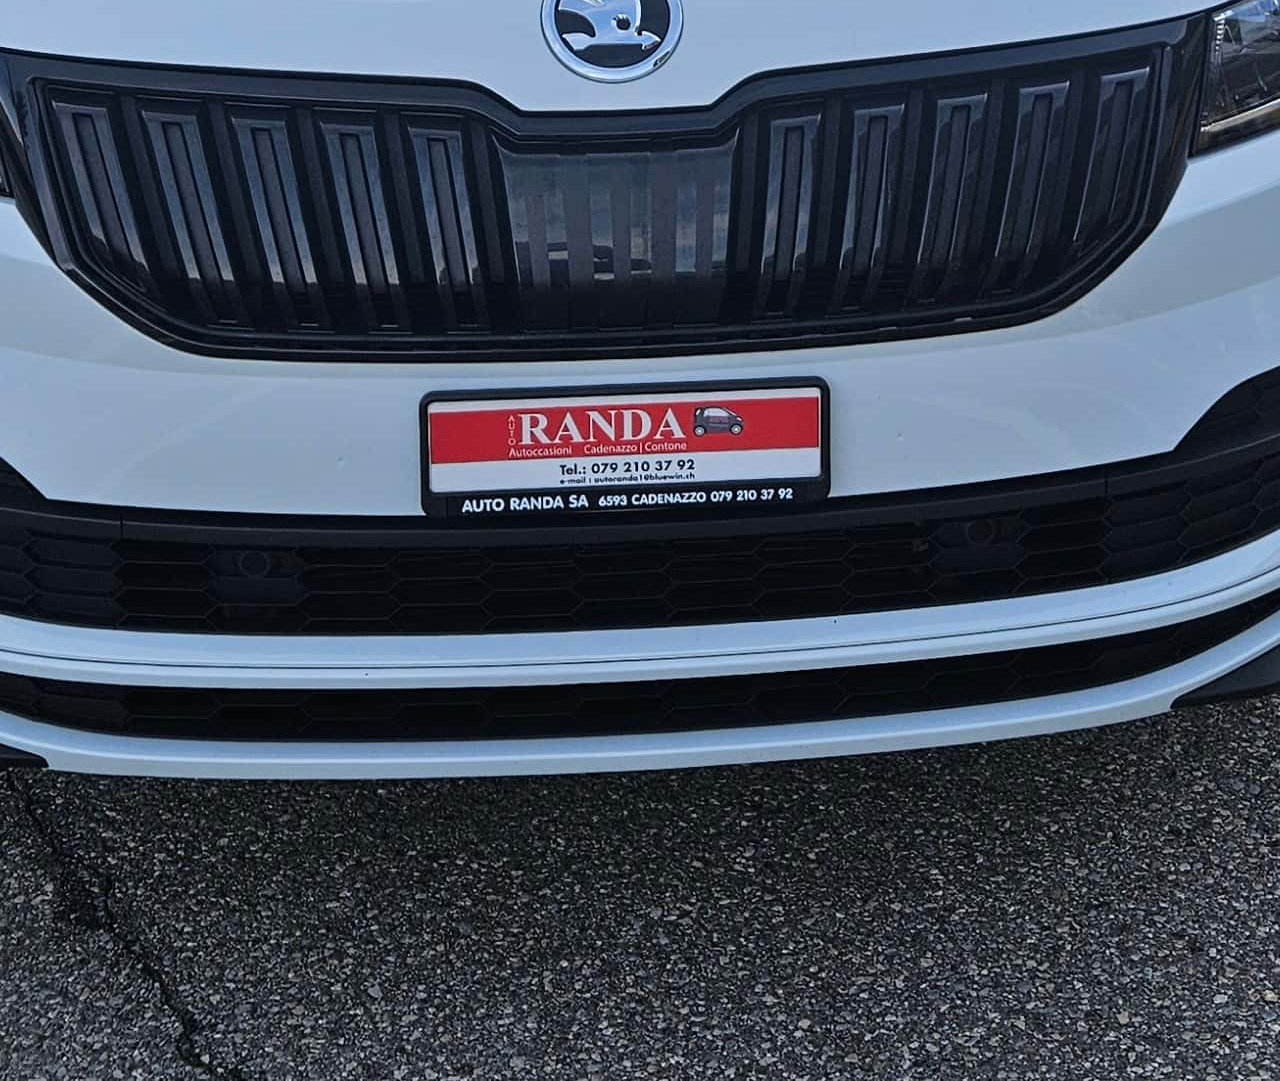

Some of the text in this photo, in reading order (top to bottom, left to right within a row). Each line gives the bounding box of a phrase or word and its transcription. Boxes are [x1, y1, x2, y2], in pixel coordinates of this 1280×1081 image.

[507, 414, 517, 446] AUTO
[517, 406, 687, 445] RANDA
[508, 441, 688, 458] Autoccasioni Cadenazzo Contone
[560, 459, 696, 476] Tel.: 079 210 37 92
[462, 488, 794, 513] AUTO RANDA SA 6593 CADENAZZO 079 210 37 92
